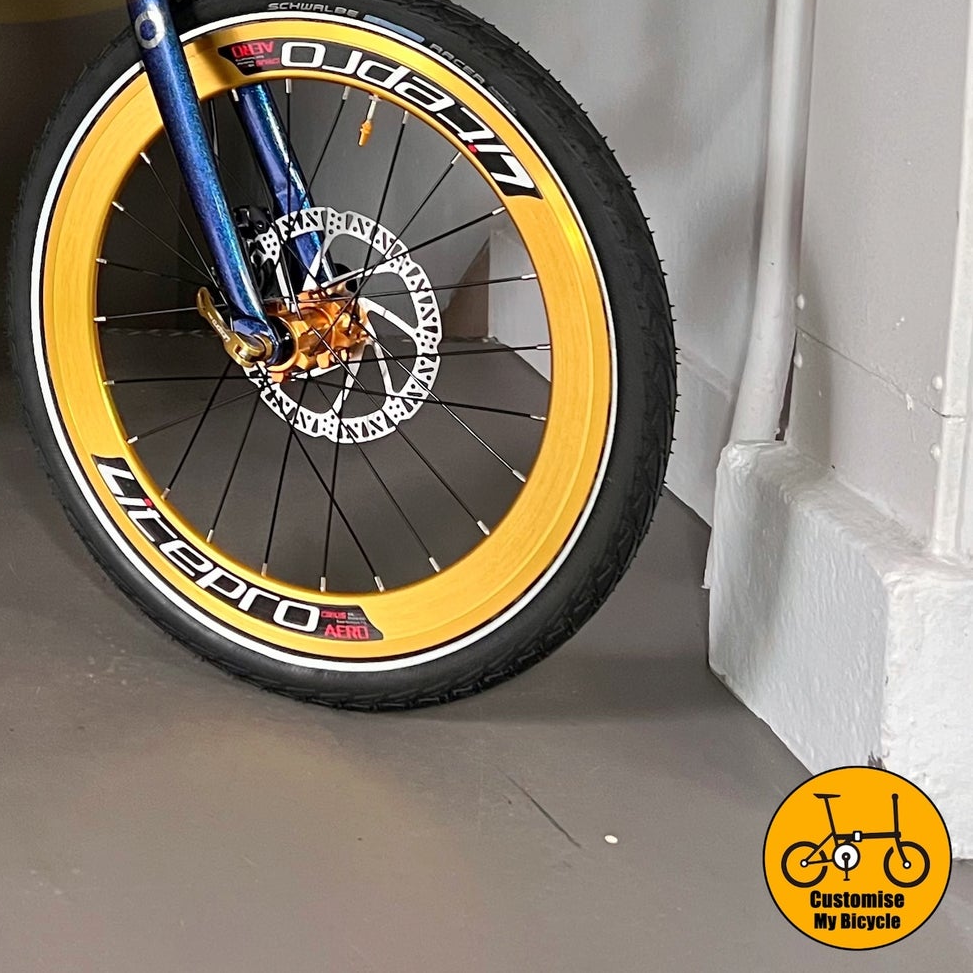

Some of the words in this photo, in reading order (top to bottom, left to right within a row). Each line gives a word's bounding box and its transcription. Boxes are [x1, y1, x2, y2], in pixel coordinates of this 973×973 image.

[267, 1, 360, 18] SCHWALBE
[280, 40, 536, 189] Litepro
[96, 463, 320, 633] Litepro
[324, 623, 370, 639] AERO
